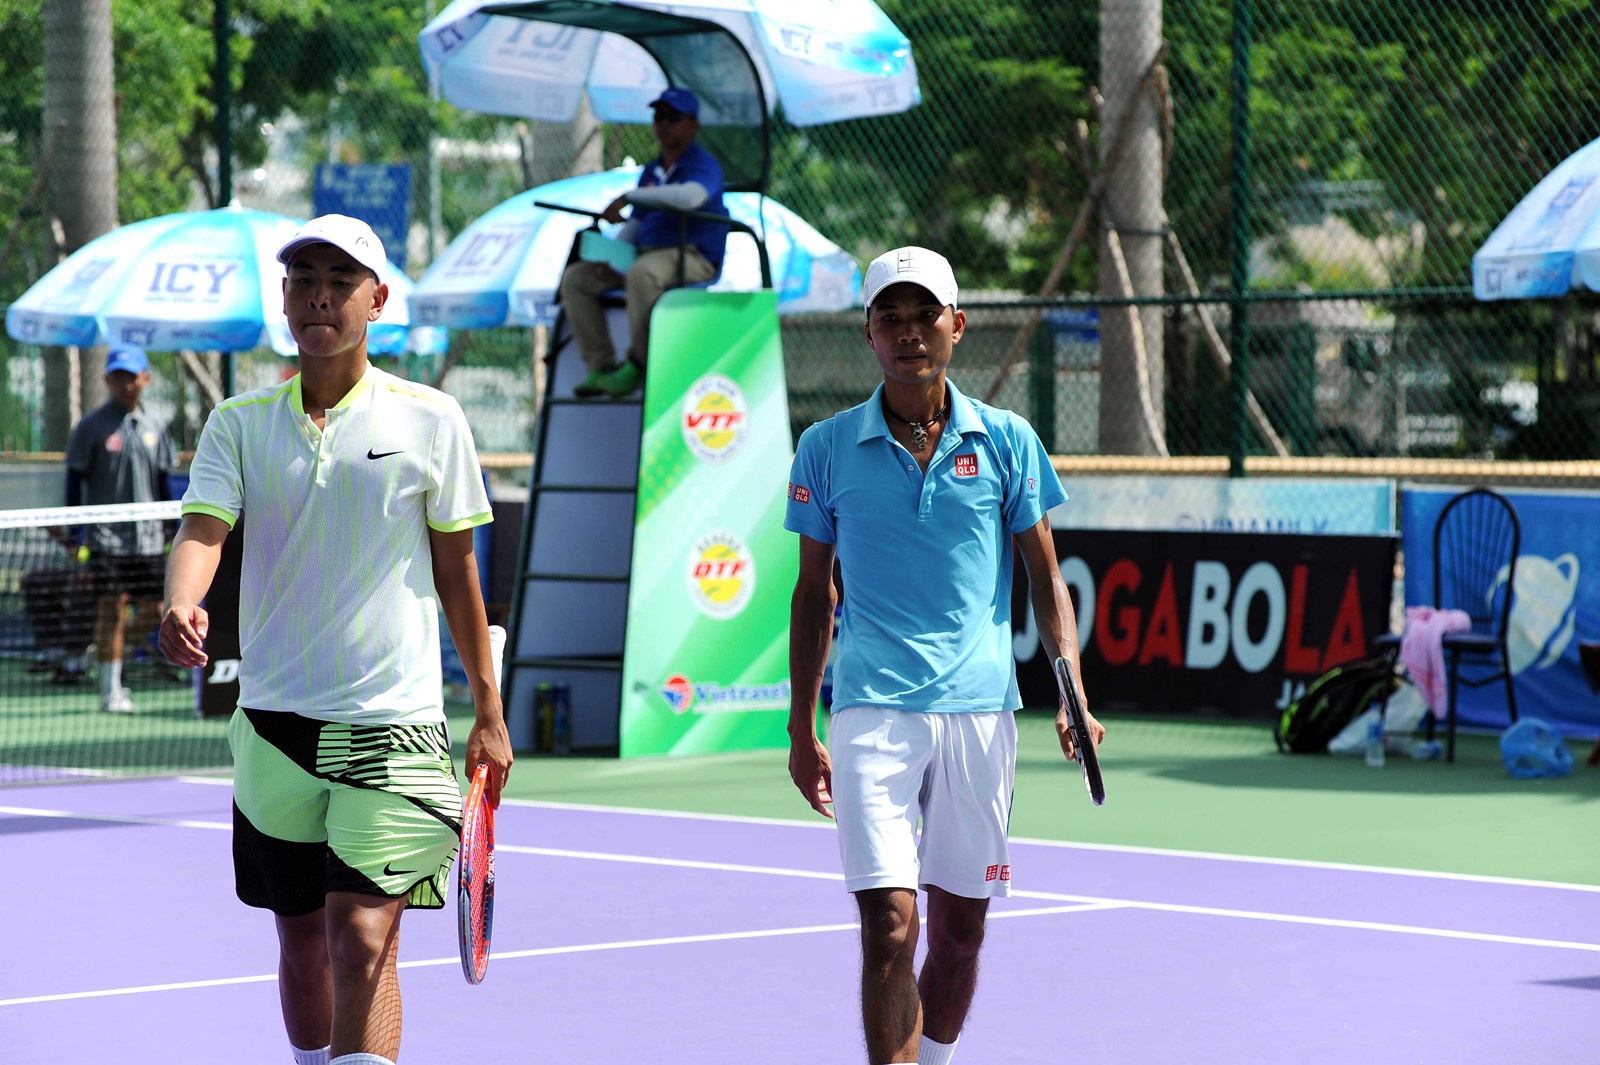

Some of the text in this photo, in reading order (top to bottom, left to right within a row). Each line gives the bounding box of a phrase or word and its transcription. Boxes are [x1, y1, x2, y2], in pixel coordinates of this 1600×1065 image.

[452, 231, 529, 267] ICY
[148, 262, 239, 295] ICY
[686, 412, 744, 430] VTF
[957, 457, 974, 465] UNI
[958, 466, 976, 475] QLO
[795, 494, 808, 502] QLO
[796, 487, 808, 495] UNI
[693, 560, 748, 578] DTF
[696, 682, 790, 703] Vietravel
